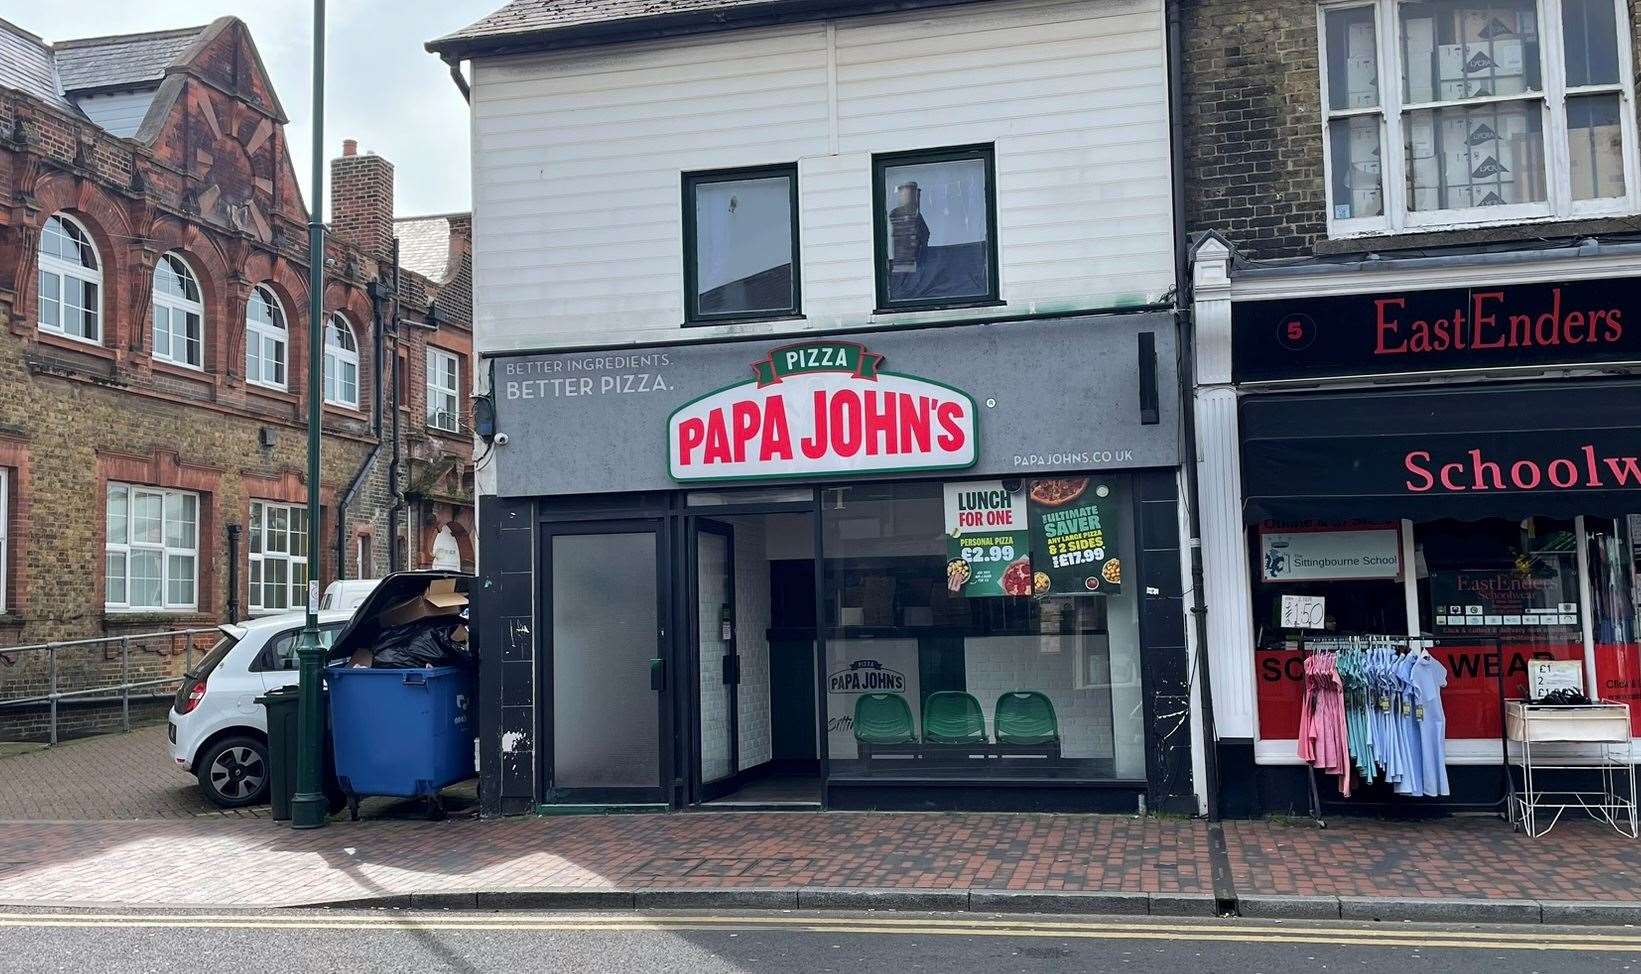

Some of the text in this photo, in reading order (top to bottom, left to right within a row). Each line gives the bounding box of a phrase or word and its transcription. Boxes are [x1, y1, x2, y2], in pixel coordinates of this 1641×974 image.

[1287, 321, 1302, 339] 5
[1374, 288, 1623, 354] EastEnders
[506, 354, 674, 375] BETTER INGREDIENTS.
[786, 347, 848, 371] PIZZA
[507, 374, 674, 400] BETTER PIZZA.
[679, 389, 965, 466] PAPA JOHN'S
[958, 490, 1012, 511] LUNCH
[959, 510, 1012, 527] FOR ONE
[1047, 505, 1099, 523] ULTIMATE
[1044, 515, 1102, 538] SAVER
[960, 536, 1014, 547] PERSONAL PIZZA
[1047, 529, 1103, 545] ANY LARGE PIZZA
[1048, 537, 1104, 555] & 2 SIDES
[961, 545, 1014, 563] £2.99
[1294, 555, 1397, 568] Sittingbourne School
[1539, 664, 1551, 673] £1
[831, 673, 902, 690] PAPA JOHN'S
[1538, 676, 1544, 685] 2
